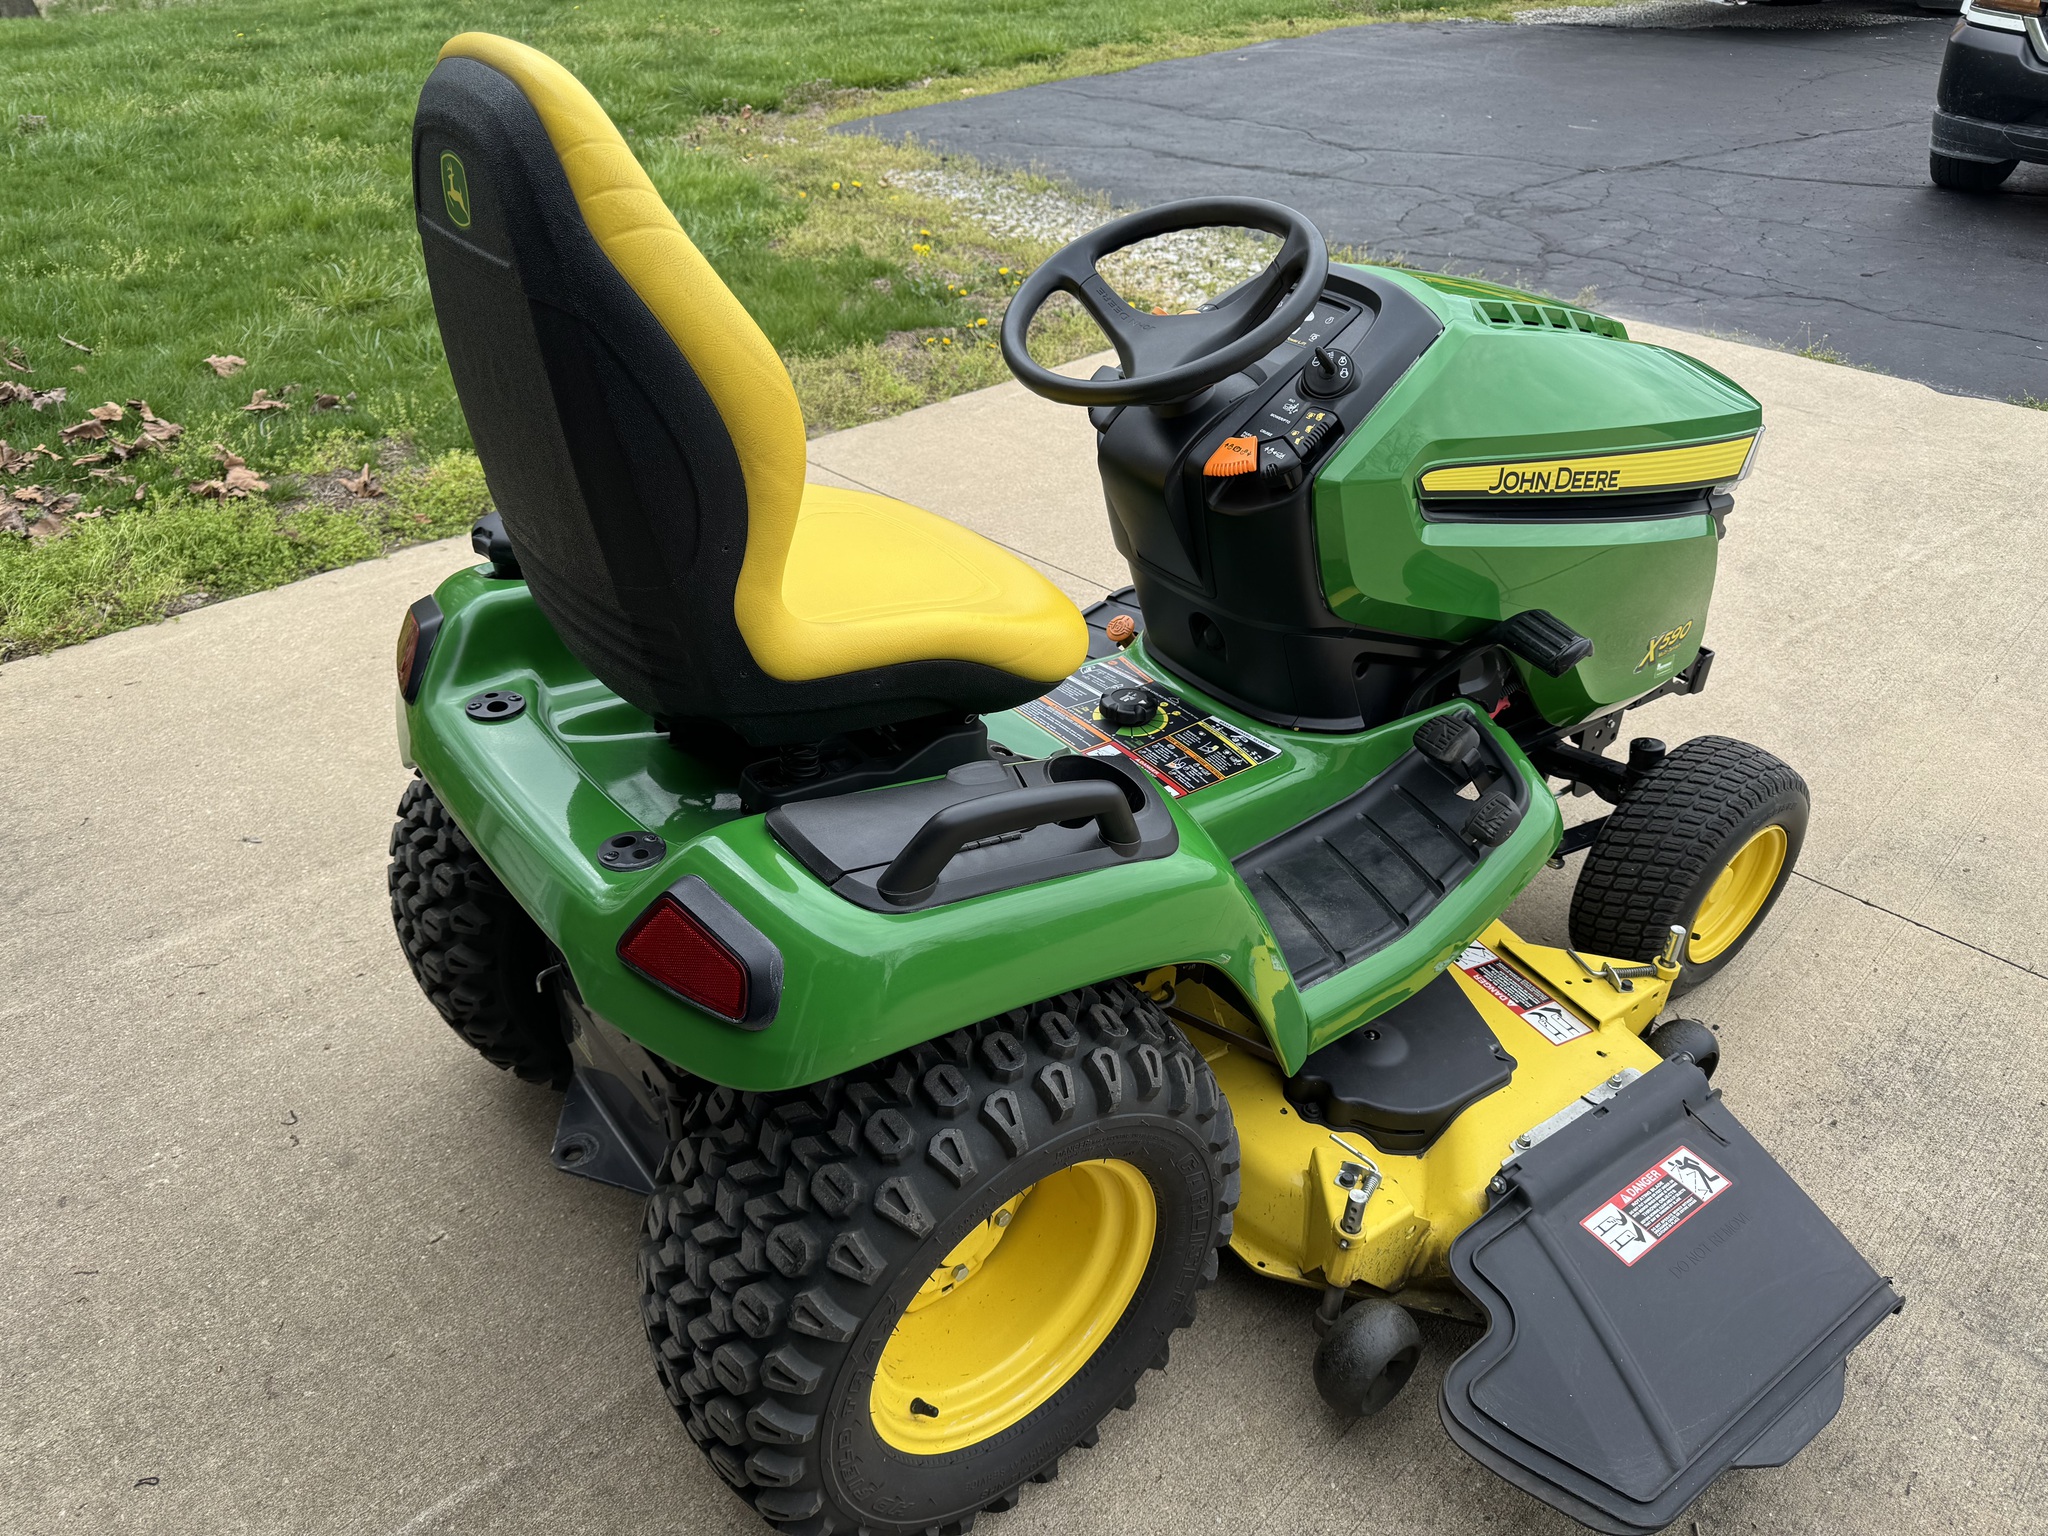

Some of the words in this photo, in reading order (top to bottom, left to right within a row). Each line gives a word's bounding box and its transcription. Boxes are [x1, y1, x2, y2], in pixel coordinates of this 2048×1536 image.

[1096, 286, 1130, 321] DEERE
[1488, 467, 1553, 493] JOHN
[1554, 466, 1621, 492] DEERE
[1634, 619, 1693, 672] X590
[1139, 759, 1160, 775] DANGER
[1472, 973, 1509, 1002] DANGER
[1626, 1169, 1662, 1197] DANGER
[1630, 1190, 1651, 1206] ROTATING
[1649, 1180, 1664, 1192] BLADE
[1641, 1201, 1660, 1216] THROWN
[1657, 1188, 1677, 1203] OBJECTS
[1163, 1151, 1211, 1316] CARLISLE
[1687, 1243, 1711, 1264] NOT
[838, 1427, 879, 1502] FIELD
